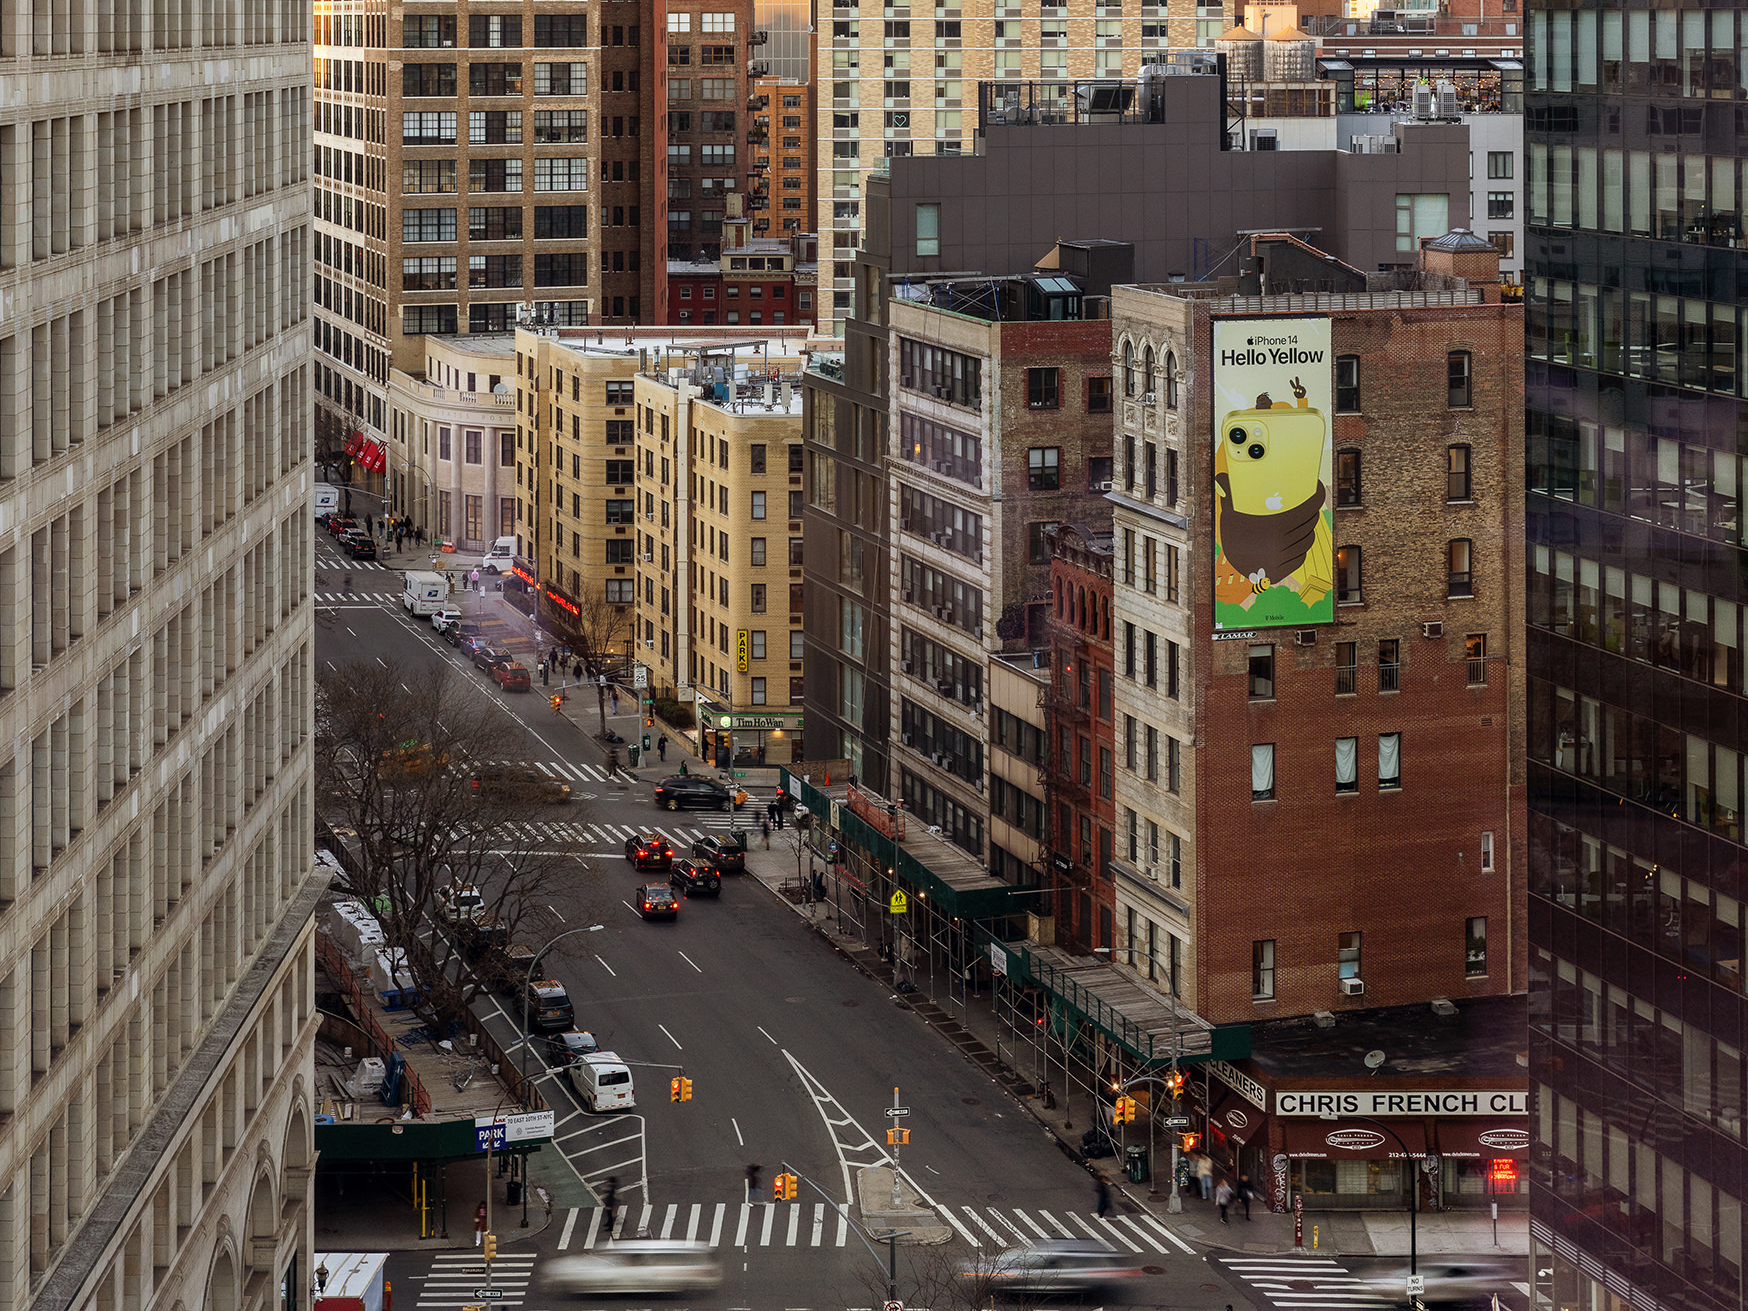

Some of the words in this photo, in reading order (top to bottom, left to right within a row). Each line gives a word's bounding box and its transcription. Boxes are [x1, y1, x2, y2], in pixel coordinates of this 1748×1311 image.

[1254, 336, 1287, 346] iPhone
[1287, 335, 1298, 345] 14
[1221, 349, 1267, 366] Hello
[1268, 347, 1324, 365] Yellow
[481, 414, 512, 423] POST
[736, 718, 753, 727] Tim
[1210, 1061, 1263, 1102] CLEANERS
[1280, 1094, 1359, 1113] CHRIS
[1372, 1094, 1478, 1112] FRENCH
[479, 1128, 504, 1141] PARK
